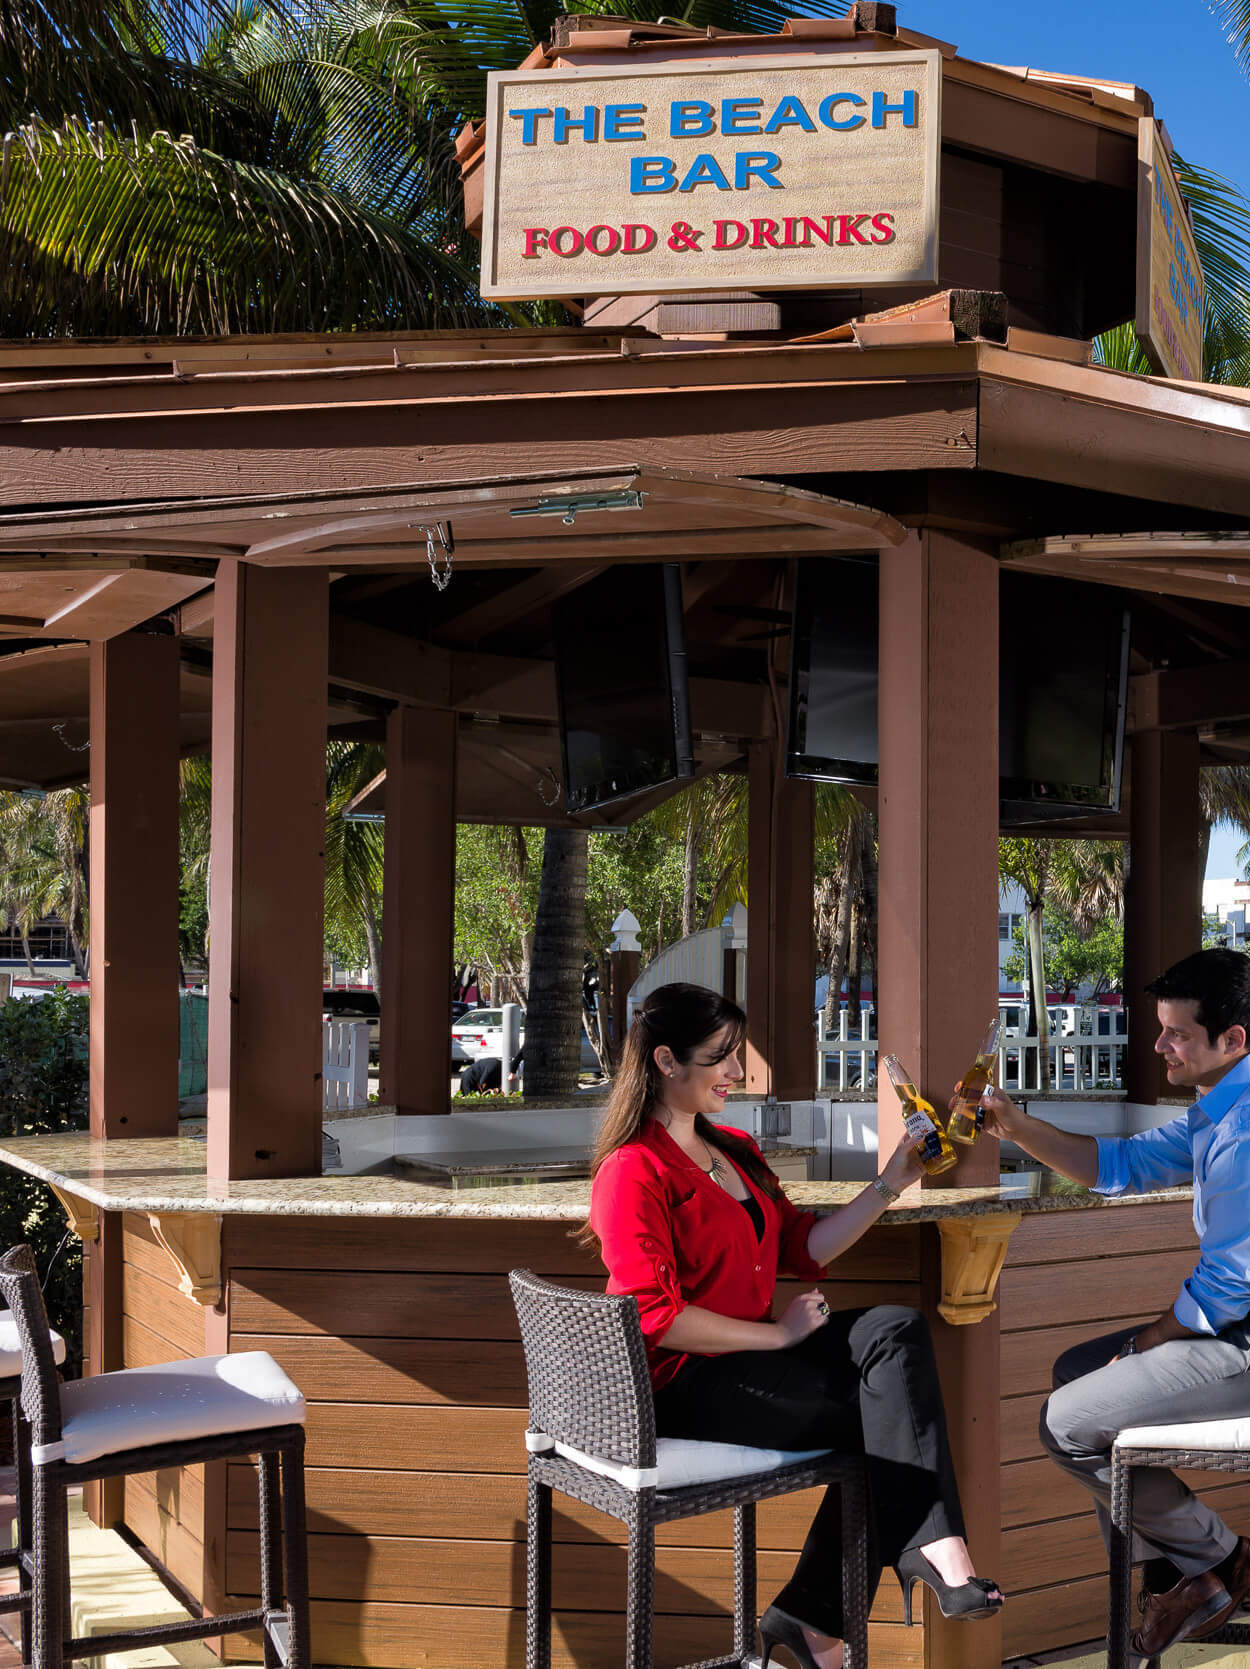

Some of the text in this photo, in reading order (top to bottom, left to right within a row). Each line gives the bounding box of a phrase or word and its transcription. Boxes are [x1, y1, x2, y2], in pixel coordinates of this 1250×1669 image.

[508, 90, 917, 144] THE BEACH
[630, 152, 783, 194] BAR
[520, 212, 895, 258] FOOD & DRINKS
[1154, 163, 1173, 244] THE
[1175, 225, 1201, 325] BEACH
[1170, 261, 1188, 332] BAR
